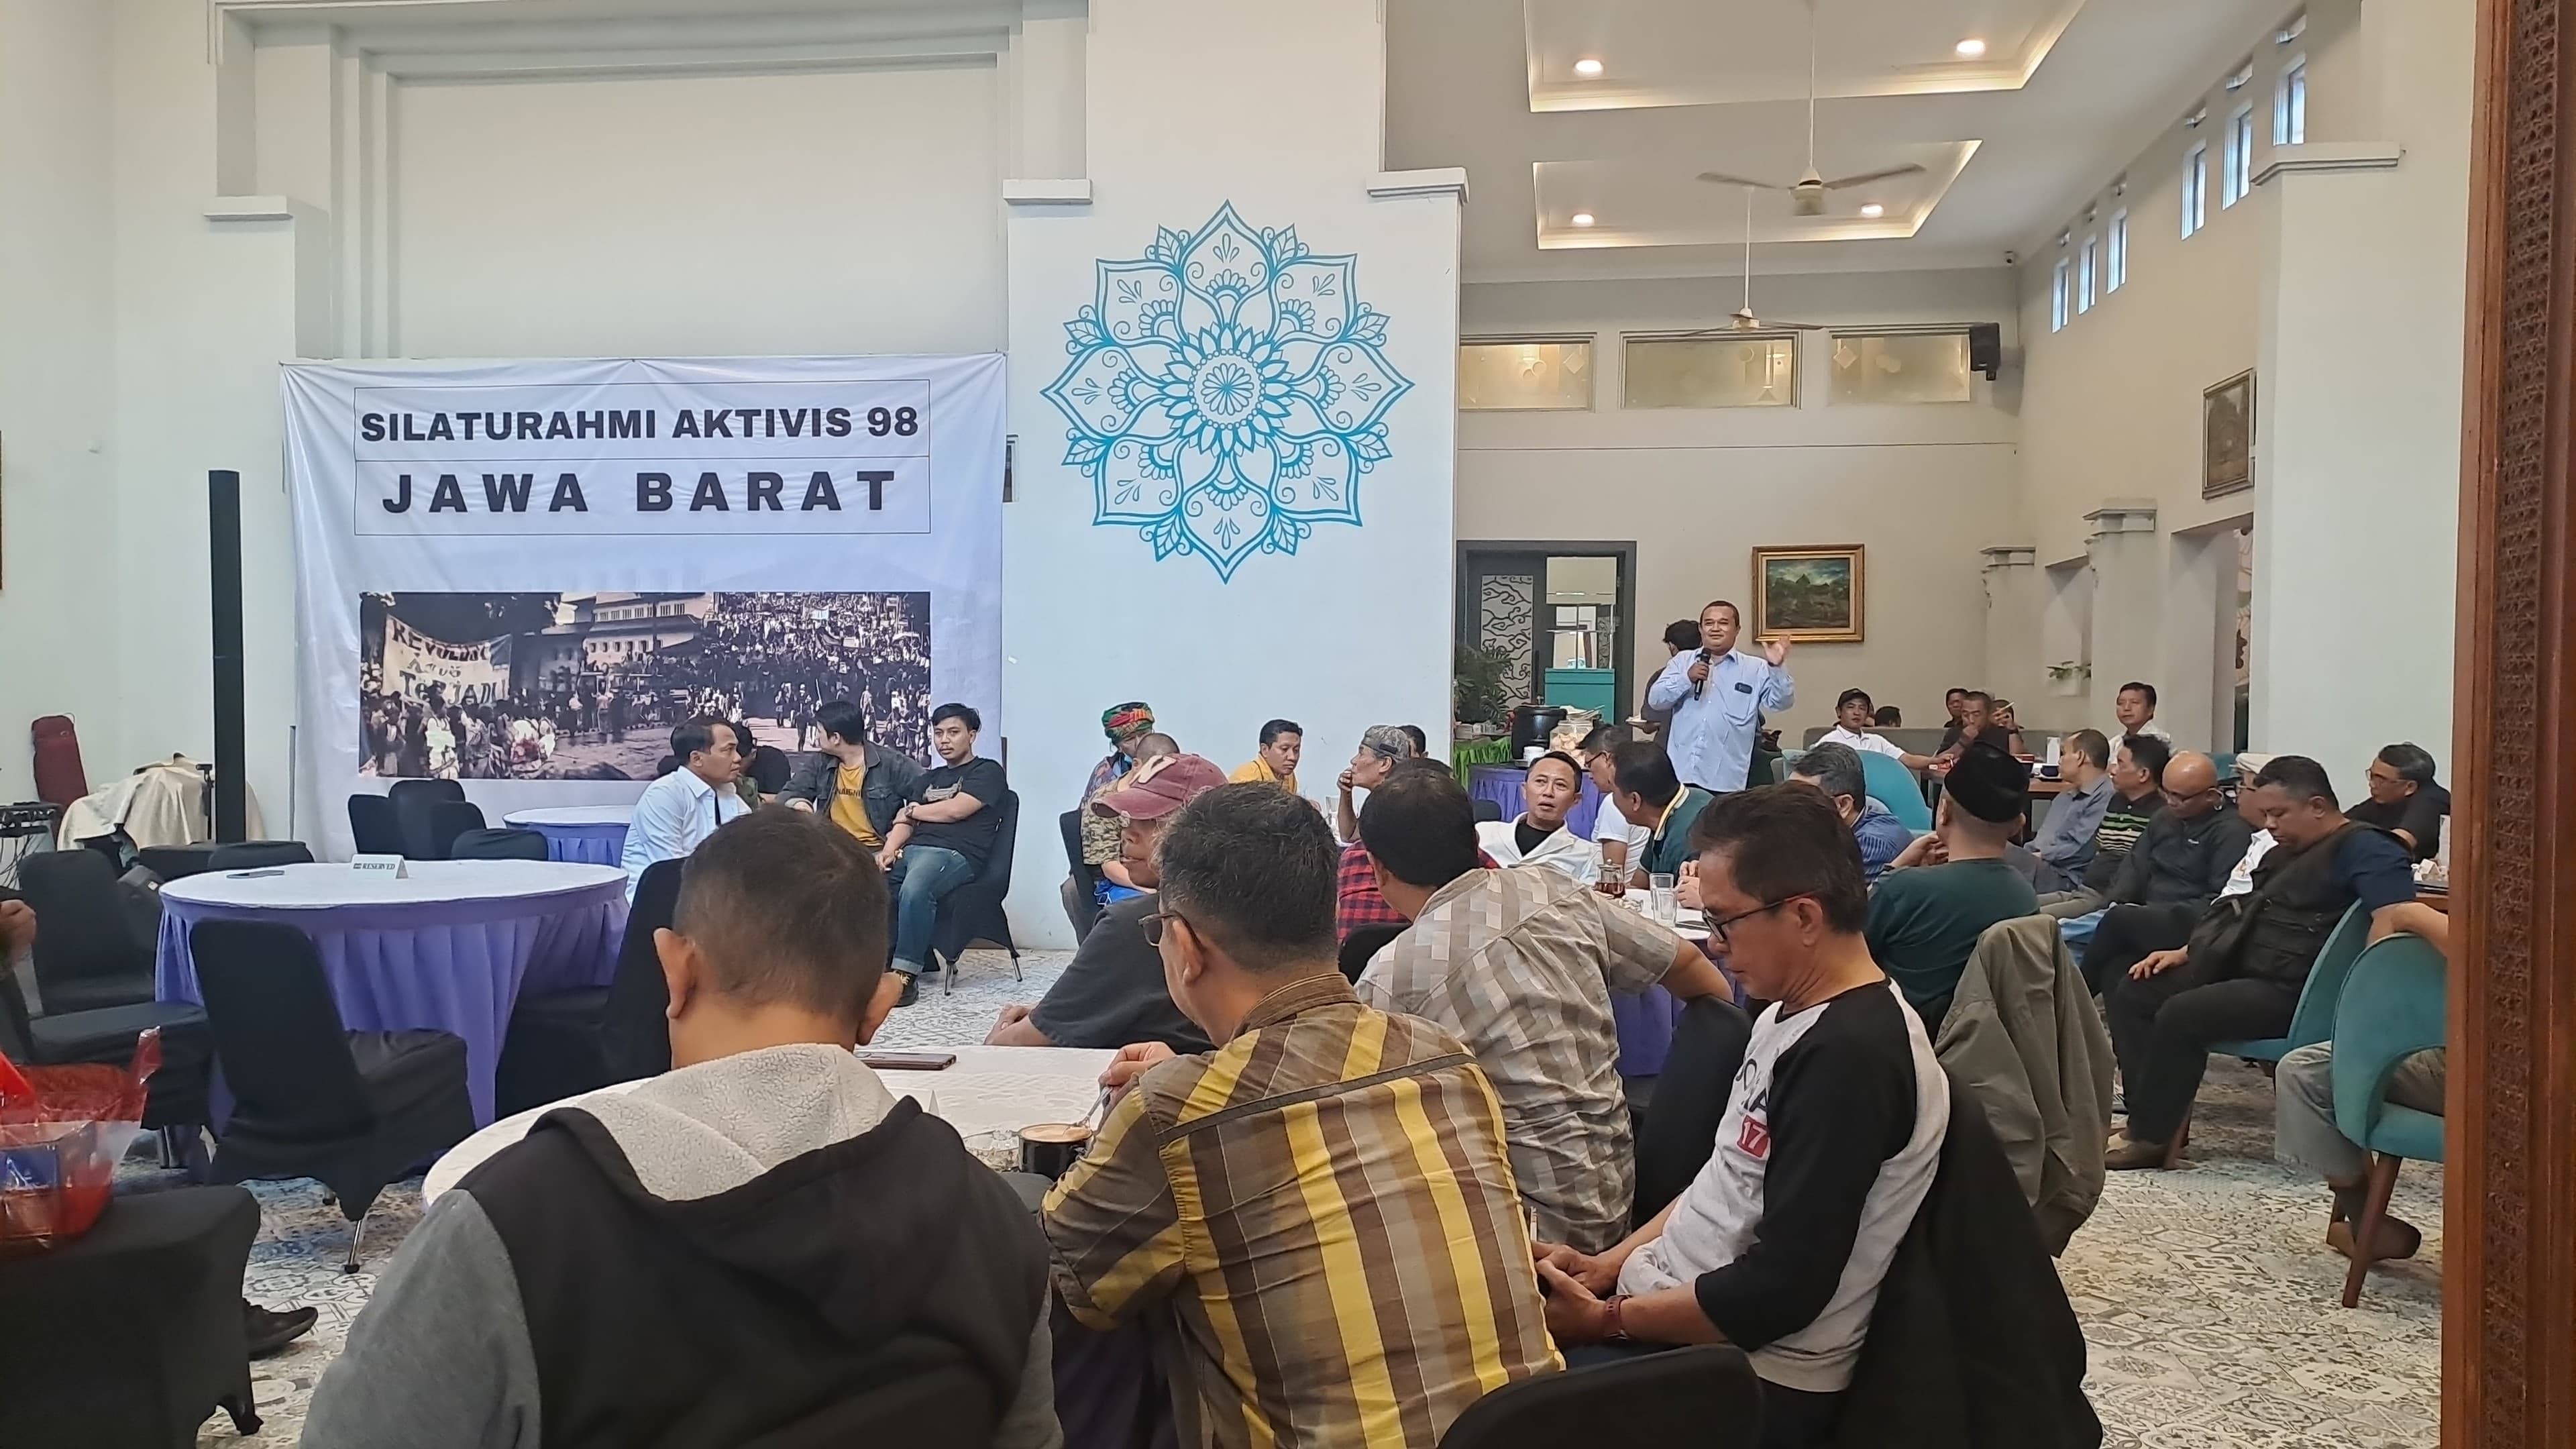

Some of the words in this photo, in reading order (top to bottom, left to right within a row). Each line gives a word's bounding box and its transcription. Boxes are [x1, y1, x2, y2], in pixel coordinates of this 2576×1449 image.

[361, 409, 655, 442] SILATURAHMI
[672, 407, 852, 438] AKTIVIS
[867, 407, 918, 437] 98
[382, 473, 588, 514] JAWA
[637, 470, 895, 512] BARAT
